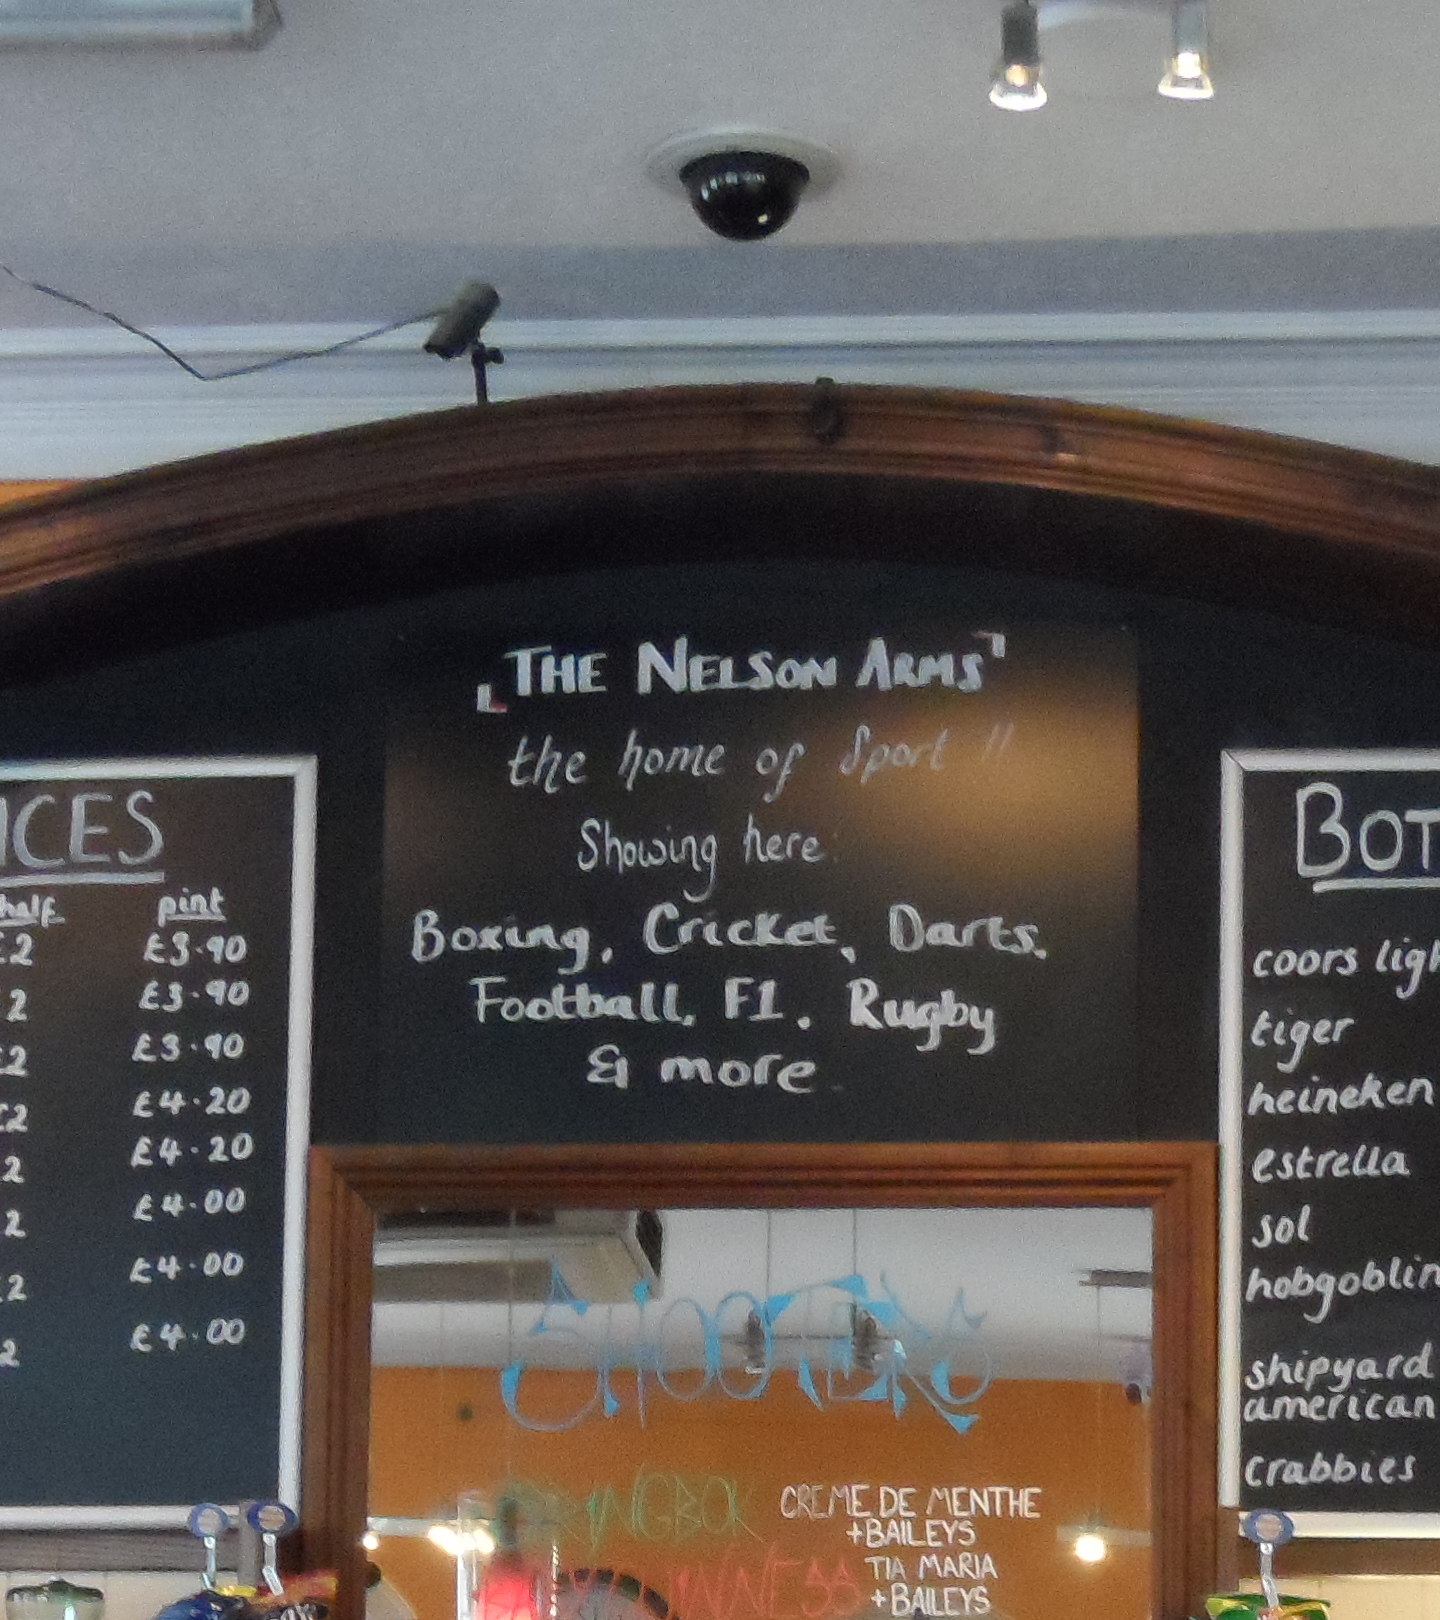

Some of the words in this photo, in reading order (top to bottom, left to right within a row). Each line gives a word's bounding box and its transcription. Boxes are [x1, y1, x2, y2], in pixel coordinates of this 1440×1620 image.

[637, 635, 837, 695] NELSON
[508, 734, 586, 794] the
[618, 729, 726, 791] home
[756, 742, 808, 802] of
[578, 817, 718, 902] Showing
[744, 814, 825, 863] here
[158, 888, 226, 925] pint
[1252, 946, 1359, 978] coors
[848, 977, 998, 1054] Rugby
[1252, 1008, 1355, 1073] tiger
[587, 1044, 629, 1089] &
[660, 1052, 817, 1093] more
[1248, 1073, 1434, 1116] heineken
[1252, 1144, 1411, 1183] estrella
[1252, 1205, 1312, 1247] sol
[1245, 1343, 1433, 1393] shipyard
[1243, 1387, 1435, 1423] american
[1245, 1451, 1417, 1488] crabbies
[780, 1483, 871, 1519] CREME
[878, 1486, 917, 1518] DE
[926, 1486, 1042, 1519] MENTHE
[864, 1556, 906, 1580] TIA
[919, 1552, 998, 1579] MARIA
